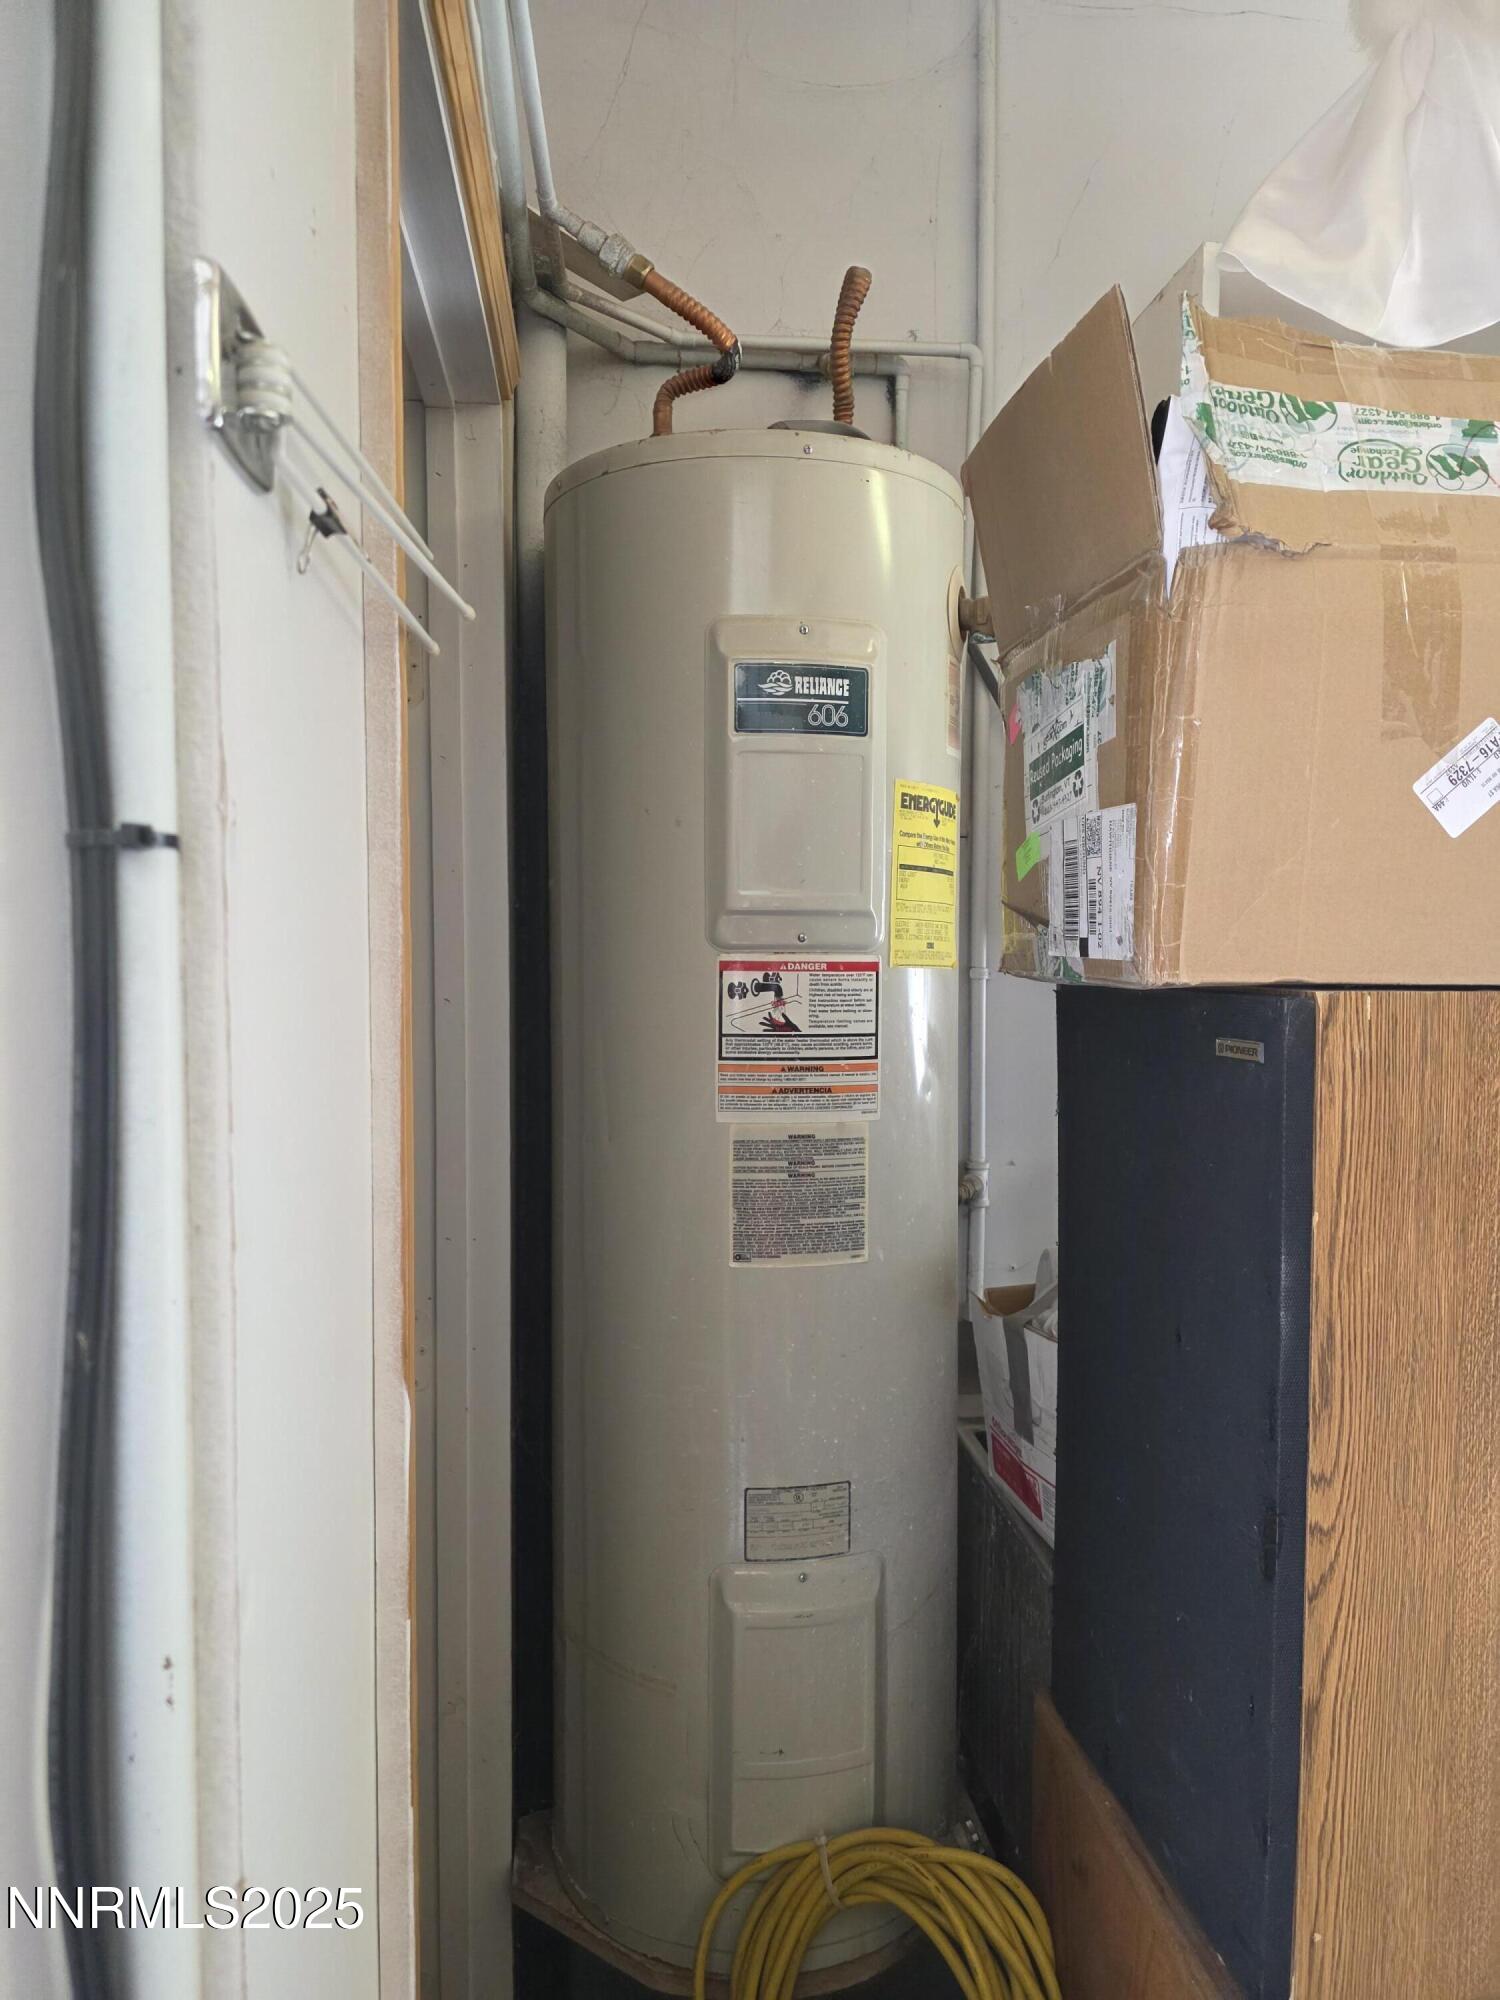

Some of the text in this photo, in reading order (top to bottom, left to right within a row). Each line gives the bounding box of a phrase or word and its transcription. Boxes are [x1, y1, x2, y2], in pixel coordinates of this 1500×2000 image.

[1353, 408, 1441, 423] 1888-547-4327
[1352, 448, 1422, 473] Gear
[1346, 468, 1428, 485] Outdoor
[795, 676, 850, 697] RELIANCE
[808, 704, 849, 727] 606
[1030, 738, 1082, 783] Reused Packaging
[1097, 866, 1102, 886] NV
[1225, 1045, 1258, 1056] PIONEER
